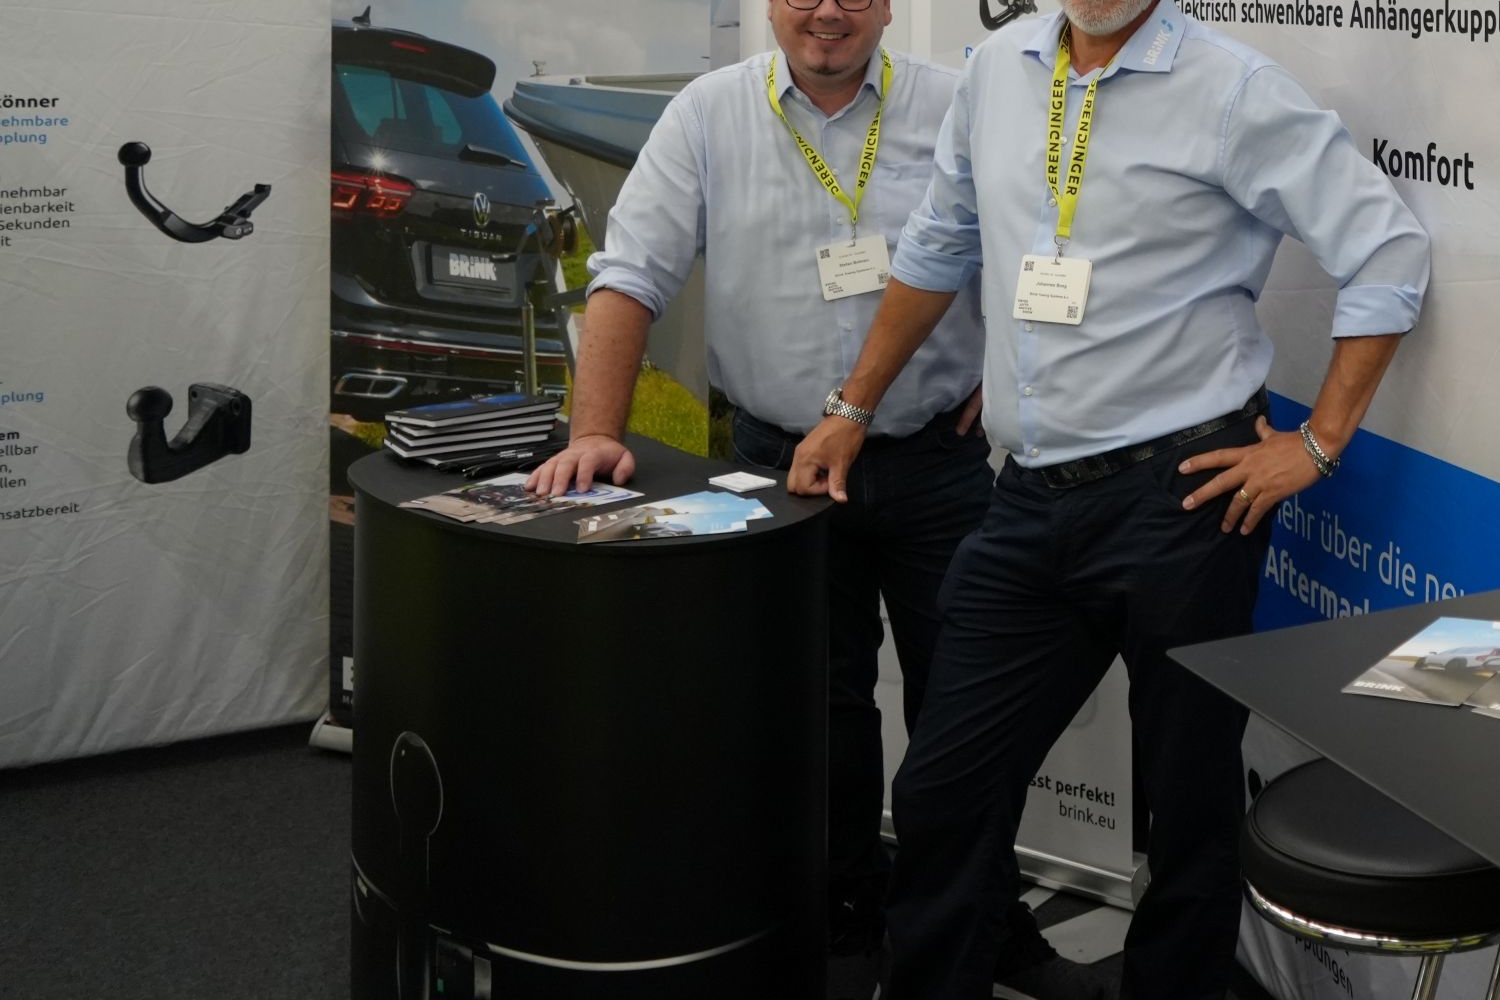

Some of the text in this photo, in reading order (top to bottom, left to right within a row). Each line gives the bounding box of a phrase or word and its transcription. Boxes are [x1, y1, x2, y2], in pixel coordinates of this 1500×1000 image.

[1373, 138, 1474, 190] Komfort
[1277, 494, 1315, 541] ehr
[1320, 511, 1372, 573] über
[1378, 541, 1416, 597] die
[1056, 780, 1115, 807] perfekt!
[1059, 800, 1116, 831] brink.eu
